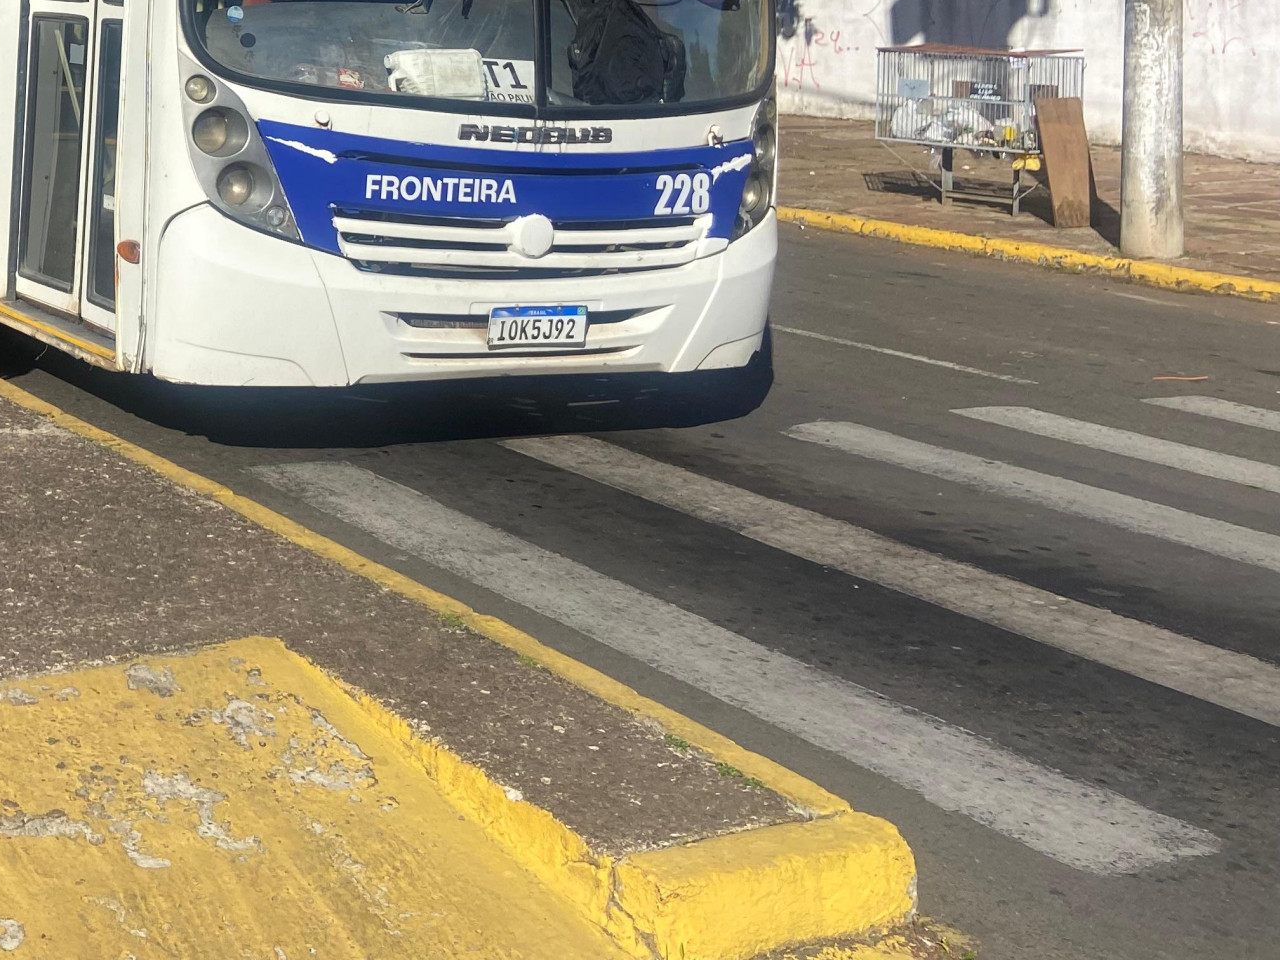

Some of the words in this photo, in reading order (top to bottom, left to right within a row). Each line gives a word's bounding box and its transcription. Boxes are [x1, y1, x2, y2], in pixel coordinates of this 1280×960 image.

[482, 60, 528, 89] T1
[488, 90, 506, 102] ÃO
[457, 123, 613, 144] NEOBUS
[365, 174, 517, 204] FRONTEIRA
[654, 172, 710, 215] 228
